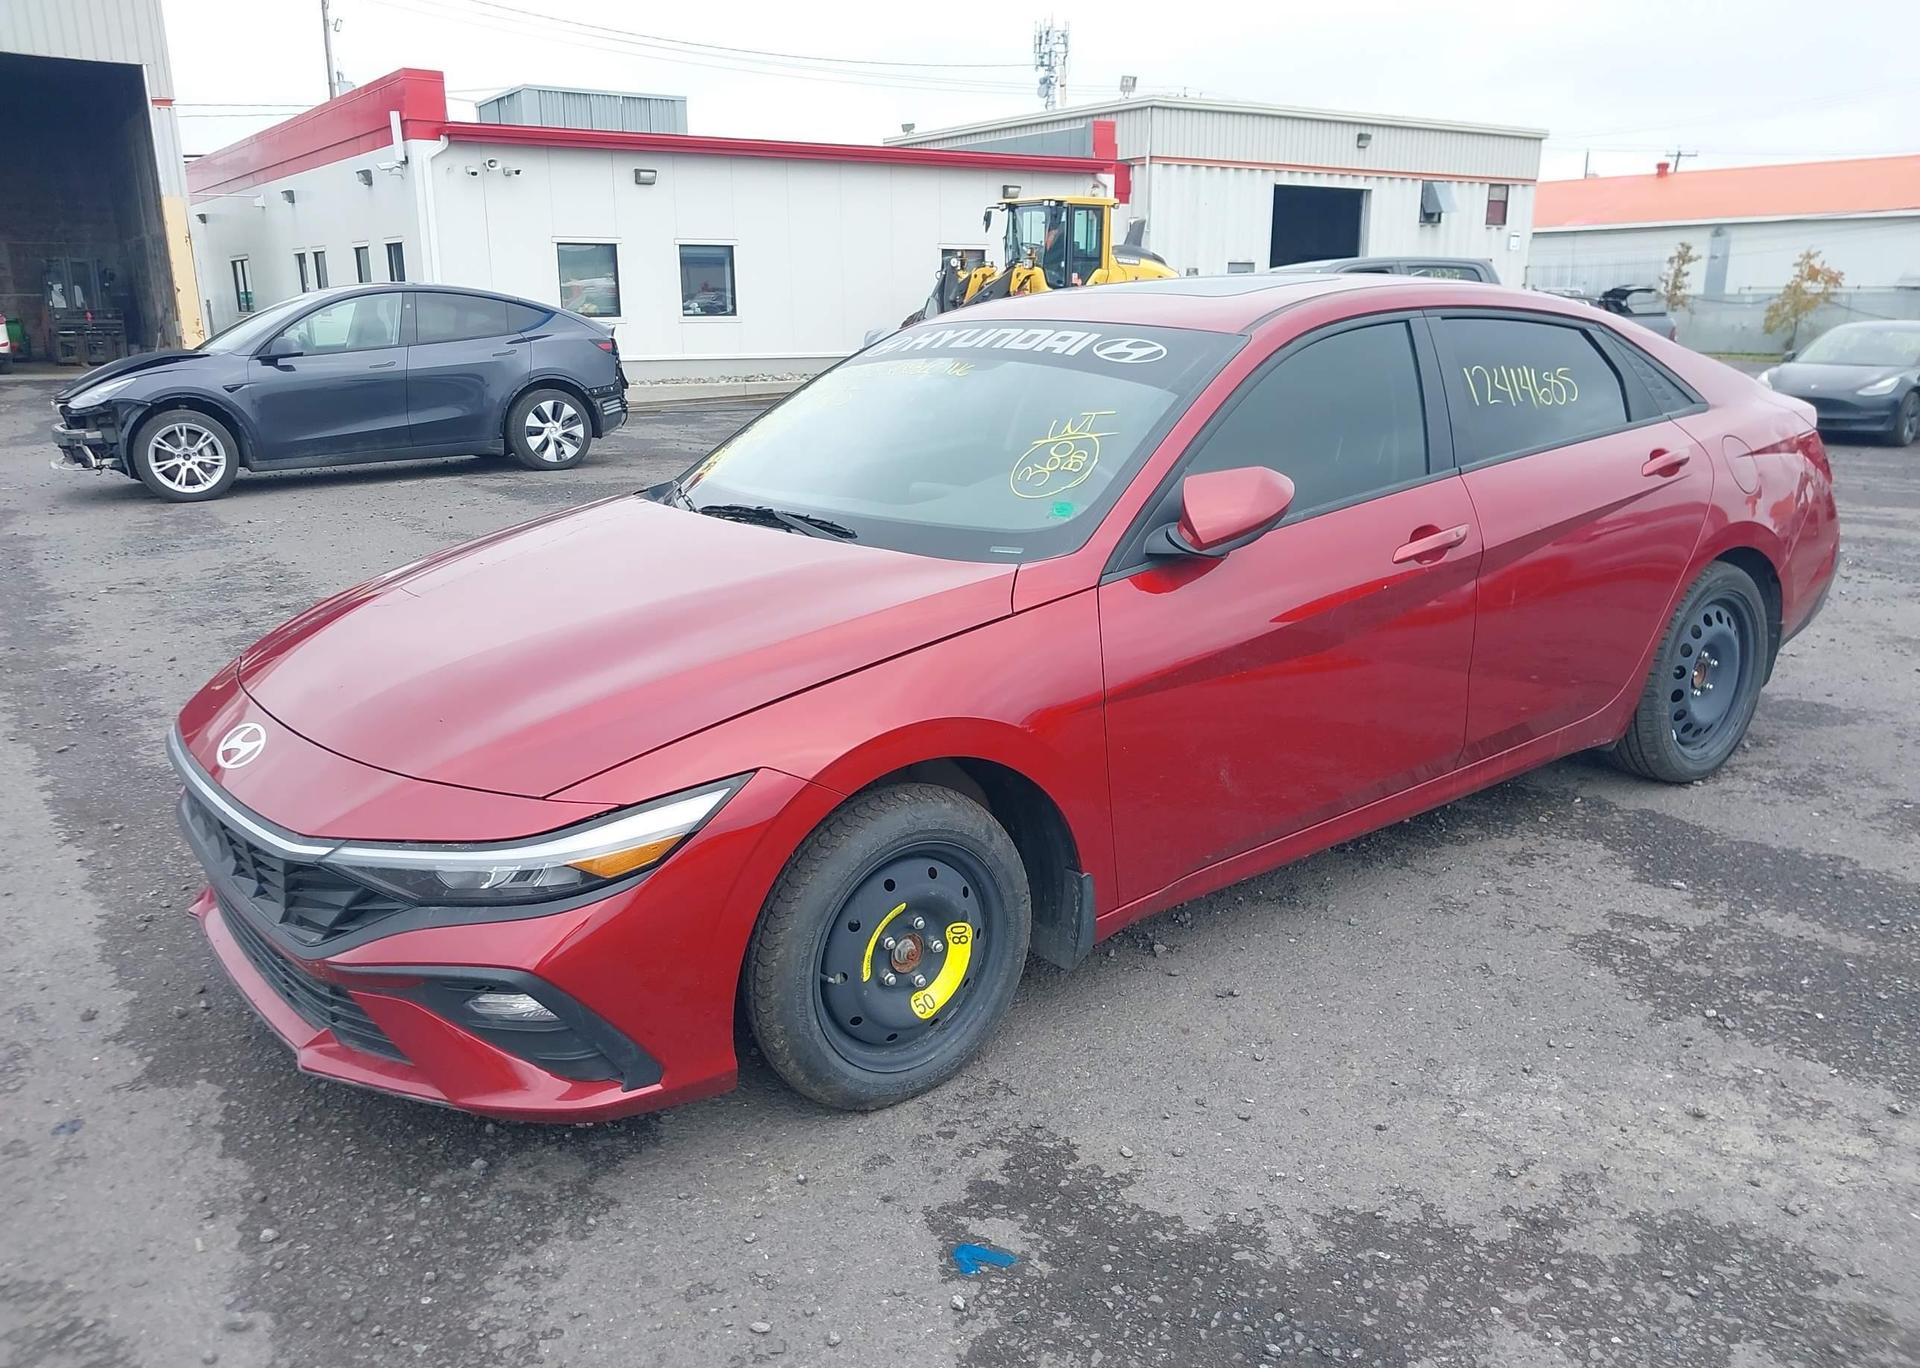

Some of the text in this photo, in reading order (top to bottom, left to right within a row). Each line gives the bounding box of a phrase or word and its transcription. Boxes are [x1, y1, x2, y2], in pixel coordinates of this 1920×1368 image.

[900, 327, 1103, 357] HYUNDAI
[1462, 364, 1579, 410] 12414685
[950, 925, 970, 945] 80
[913, 993, 936, 1015] 50
